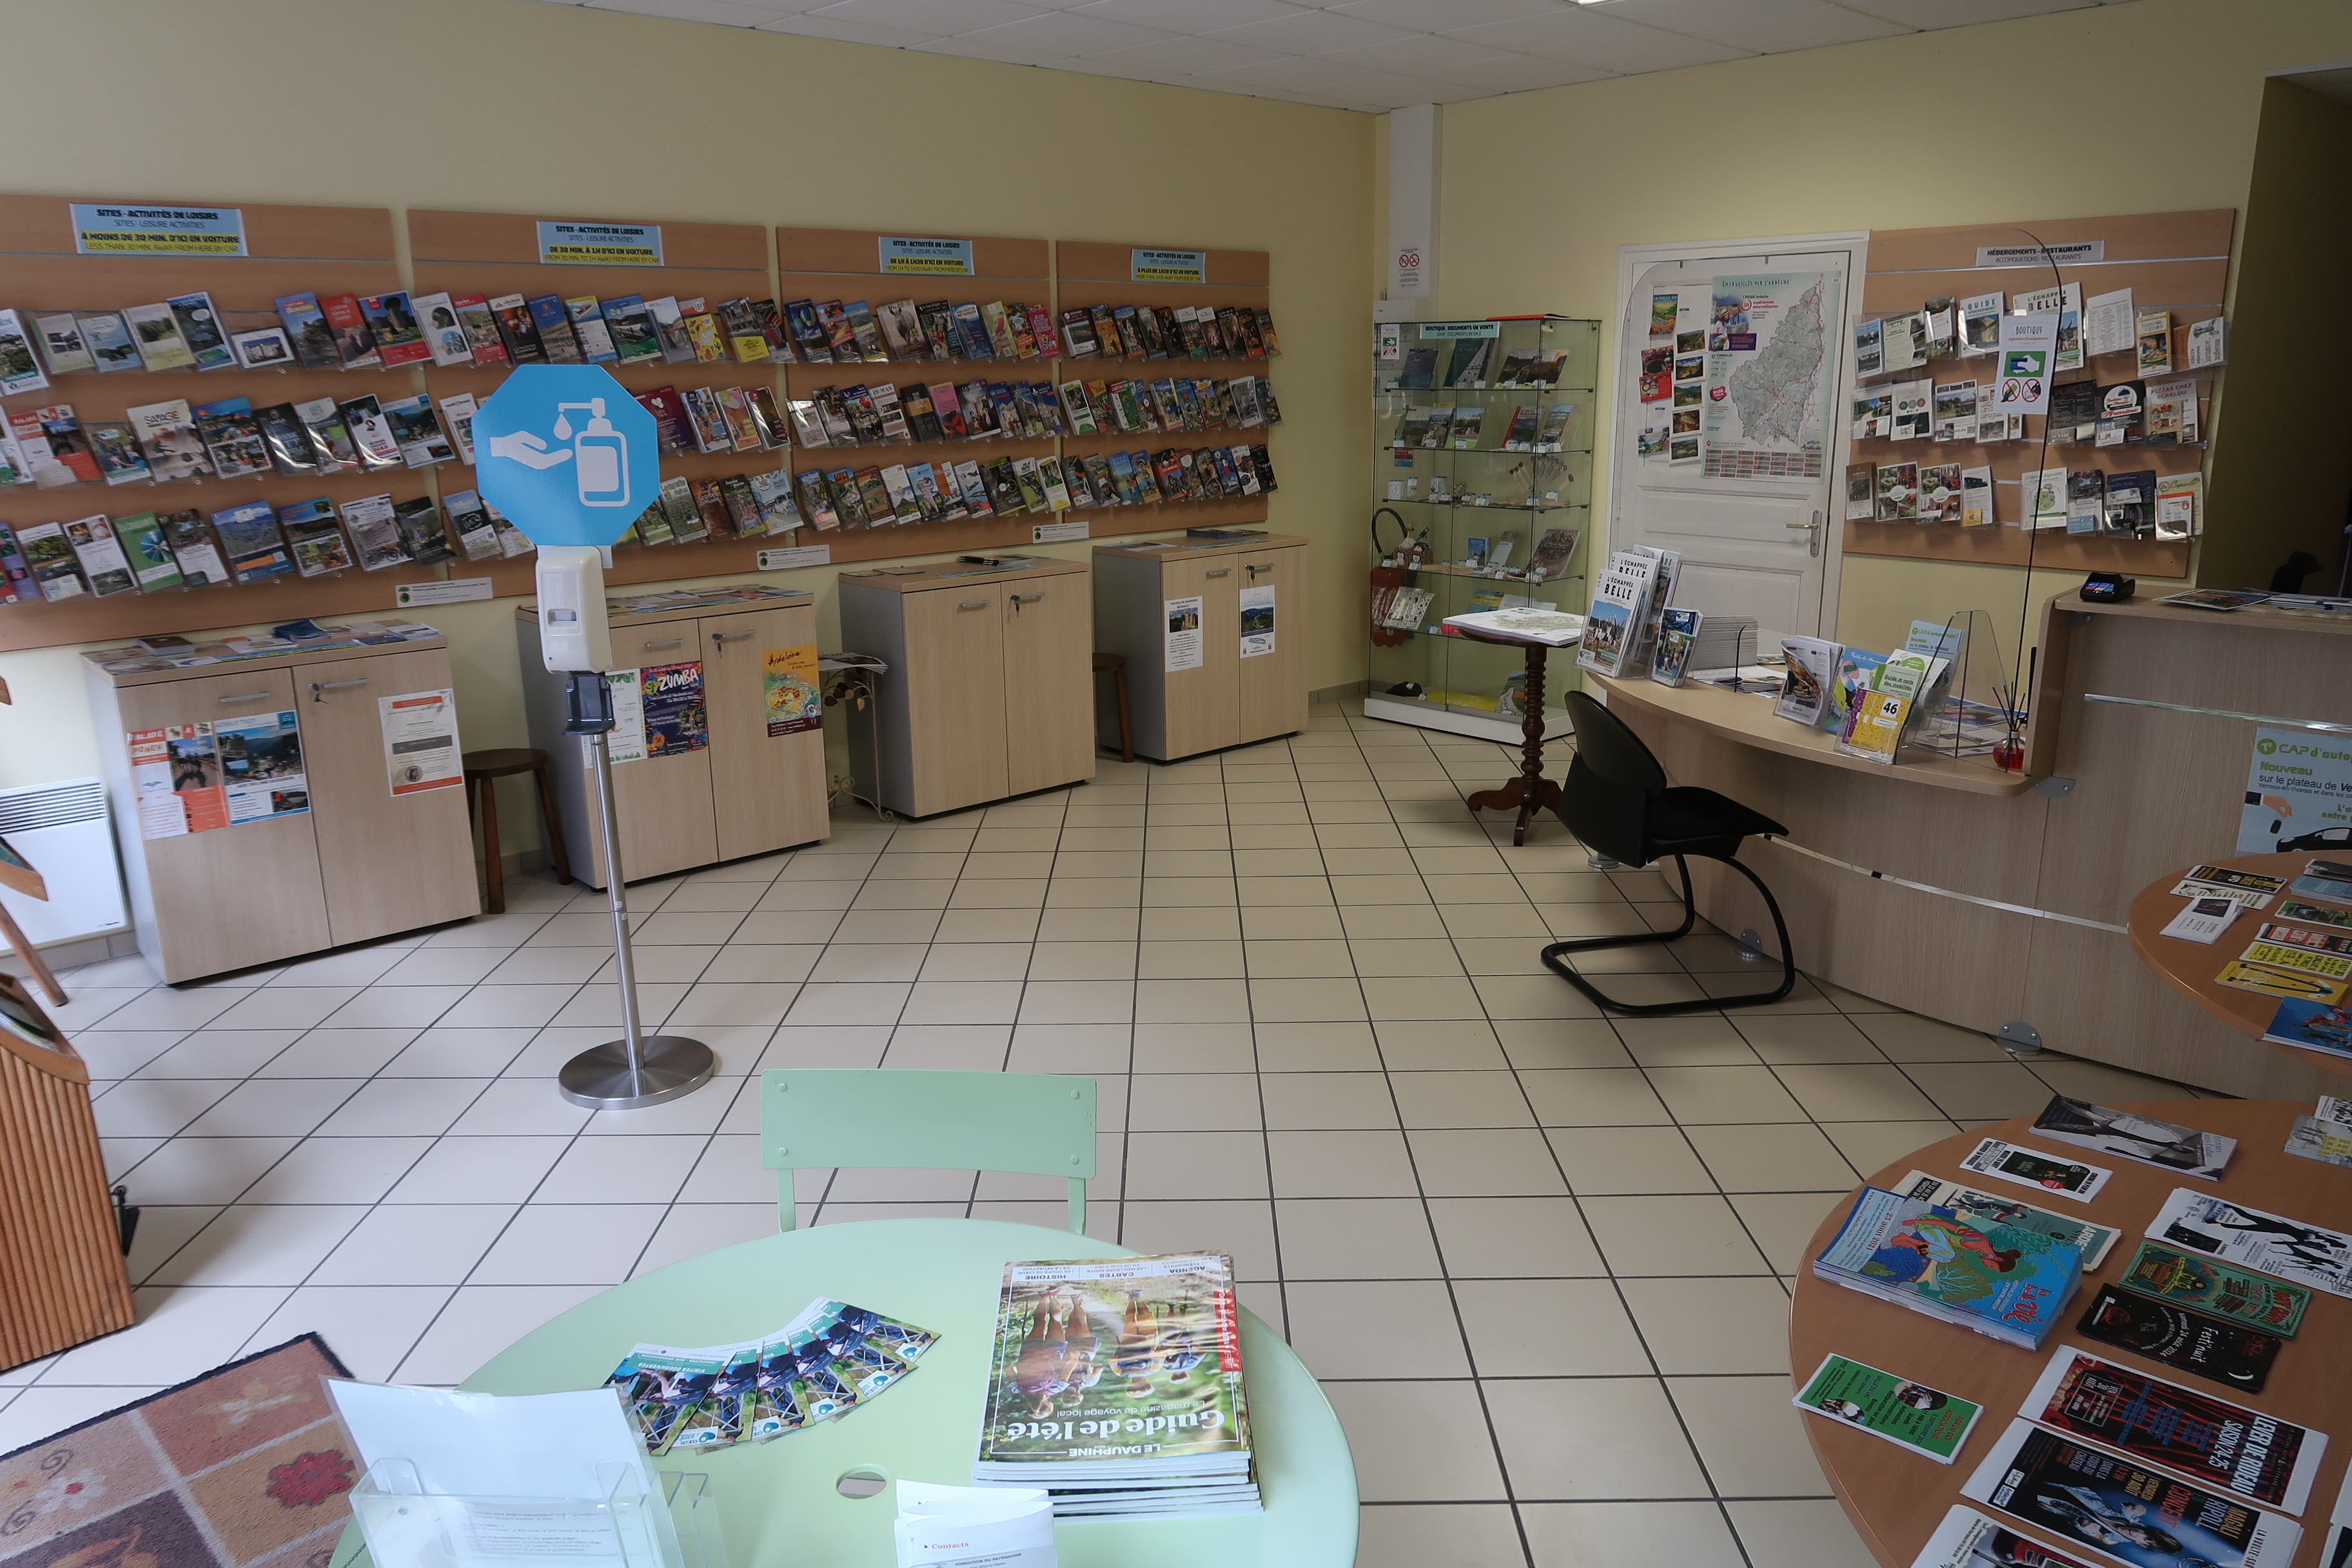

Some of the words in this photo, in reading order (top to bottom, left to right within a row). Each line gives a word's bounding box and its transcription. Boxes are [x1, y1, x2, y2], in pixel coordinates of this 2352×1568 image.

[127, 209, 172, 219] ACTIVITÉS
[186, 211, 219, 220] LOISIRS
[578, 226, 611, 234] ACTIVITÉS
[1986, 247, 2036, 257] HÉBERGEMENTS
[1968, 298, 1996, 309] GUIDE
[2015, 326, 2043, 335] BOUTIQUE
[2176, 383, 2192, 391] CHEZ
[1620, 559, 1648, 569] L'ÉCHAPPÉE
[1607, 576, 1634, 588] L'ÉCHAPPÉE
[1604, 584, 1632, 600] BELLE
[768, 650, 801, 666] Ardelaine
[658, 669, 698, 691] ZUMBA
[1885, 674, 1897, 683] Guide
[1883, 701, 1898, 714] 46
[2278, 744, 2309, 755] CAP
[2260, 761, 2313, 776] Nouveau
[2276, 775, 2284, 784] le
[2288, 778, 2322, 789] plateau
[2324, 781, 2337, 790] de
[2322, 812, 2346, 821] entre
[1883, 1212, 1894, 1220] 25
[1874, 1220, 1889, 1236] août
[1865, 1237, 1880, 1251] 2024
[2016, 1283, 2042, 1304] belle
[2036, 1287, 2052, 1298] la
[2001, 1296, 2049, 1331] vie
[2159, 1346, 2179, 1357] 2024
[2186, 1326, 2221, 1364] Festi'nuit
[637, 1362, 681, 1371] DÉCOUVERTES
[1140, 1401, 1190, 1413] magazine
[1192, 1399, 1205, 1408] Le
[1084, 1407, 1122, 1416] voyage
[1079, 1418, 1120, 1438] de
[1126, 1409, 1224, 1436] Guide
[1930, 1409, 1954, 1440] ASSOCIATIONS
[1949, 1416, 1964, 1432] FORUM
[1006, 1420, 1073, 1440] l'été
[1944, 1432, 1954, 1441] DES
[2215, 1419, 2243, 1448] SAISON
[2246, 1415, 2278, 1446] LEVER
[1144, 1443, 1161, 1452] LE
[2241, 1441, 2268, 1460] DE
[2067, 1450, 2088, 1471] CHÂTEAU
[2085, 1455, 2100, 1469] COUR
[2206, 1444, 2234, 1470] 24-25
[2082, 1466, 2094, 1475] DU
[2097, 1460, 2113, 1474] DANS
[2095, 1471, 2108, 1480] LA
[2130, 1471, 2145, 1482] 30
[2229, 1455, 2263, 1494] RIDEAU
[2123, 1478, 2144, 1496] AOÛT
[2139, 1476, 2160, 1502] VENDREDI
[2155, 1484, 2192, 1528] CONCERT
[2195, 1497, 2228, 1532] RIPOLL
[2219, 1505, 2248, 1539] MAGALI
